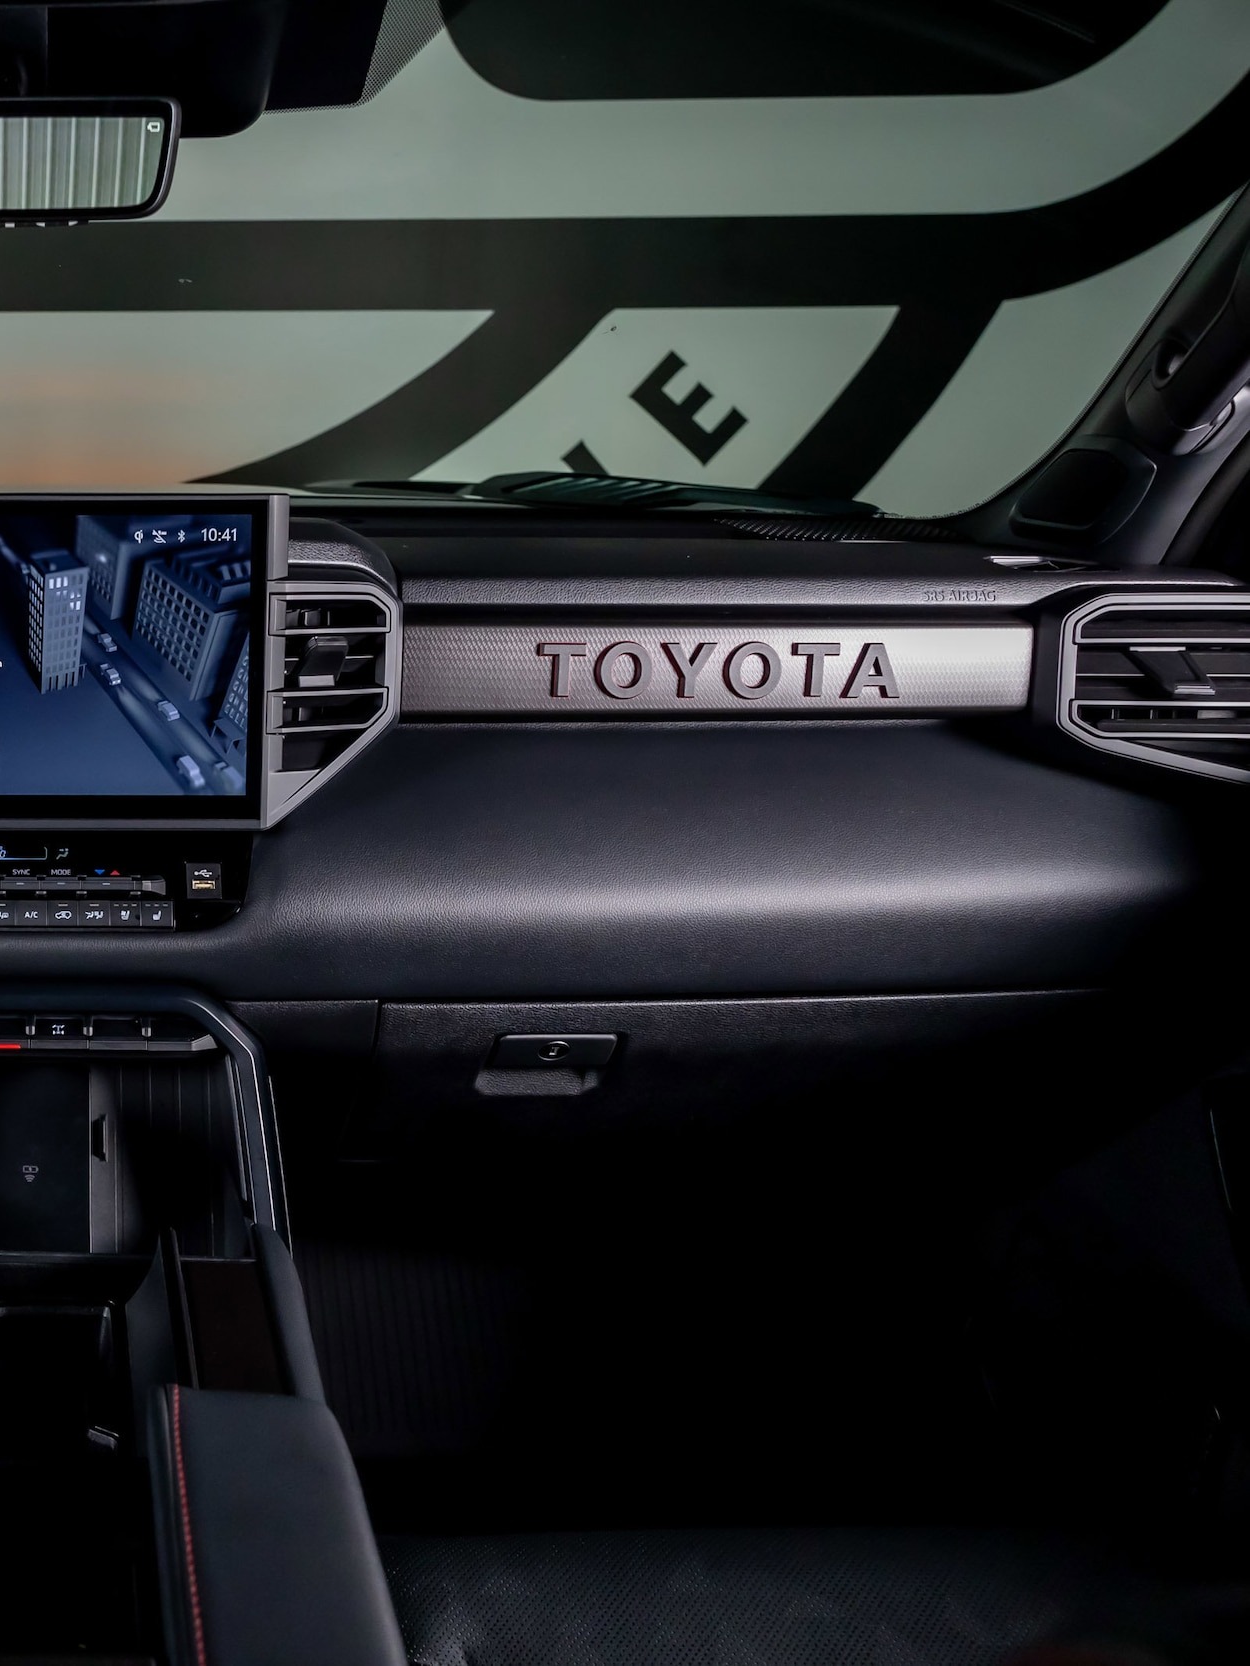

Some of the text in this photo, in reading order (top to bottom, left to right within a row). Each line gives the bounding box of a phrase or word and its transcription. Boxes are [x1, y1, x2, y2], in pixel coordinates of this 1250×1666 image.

[201, 528, 238, 541] 10:41
[949, 589, 996, 601] AIRBAG
[537, 641, 900, 700] TOYOTA
[12, 868, 31, 876] SYNC
[50, 868, 72, 876] MODE
[24, 911, 39, 919] A/C
